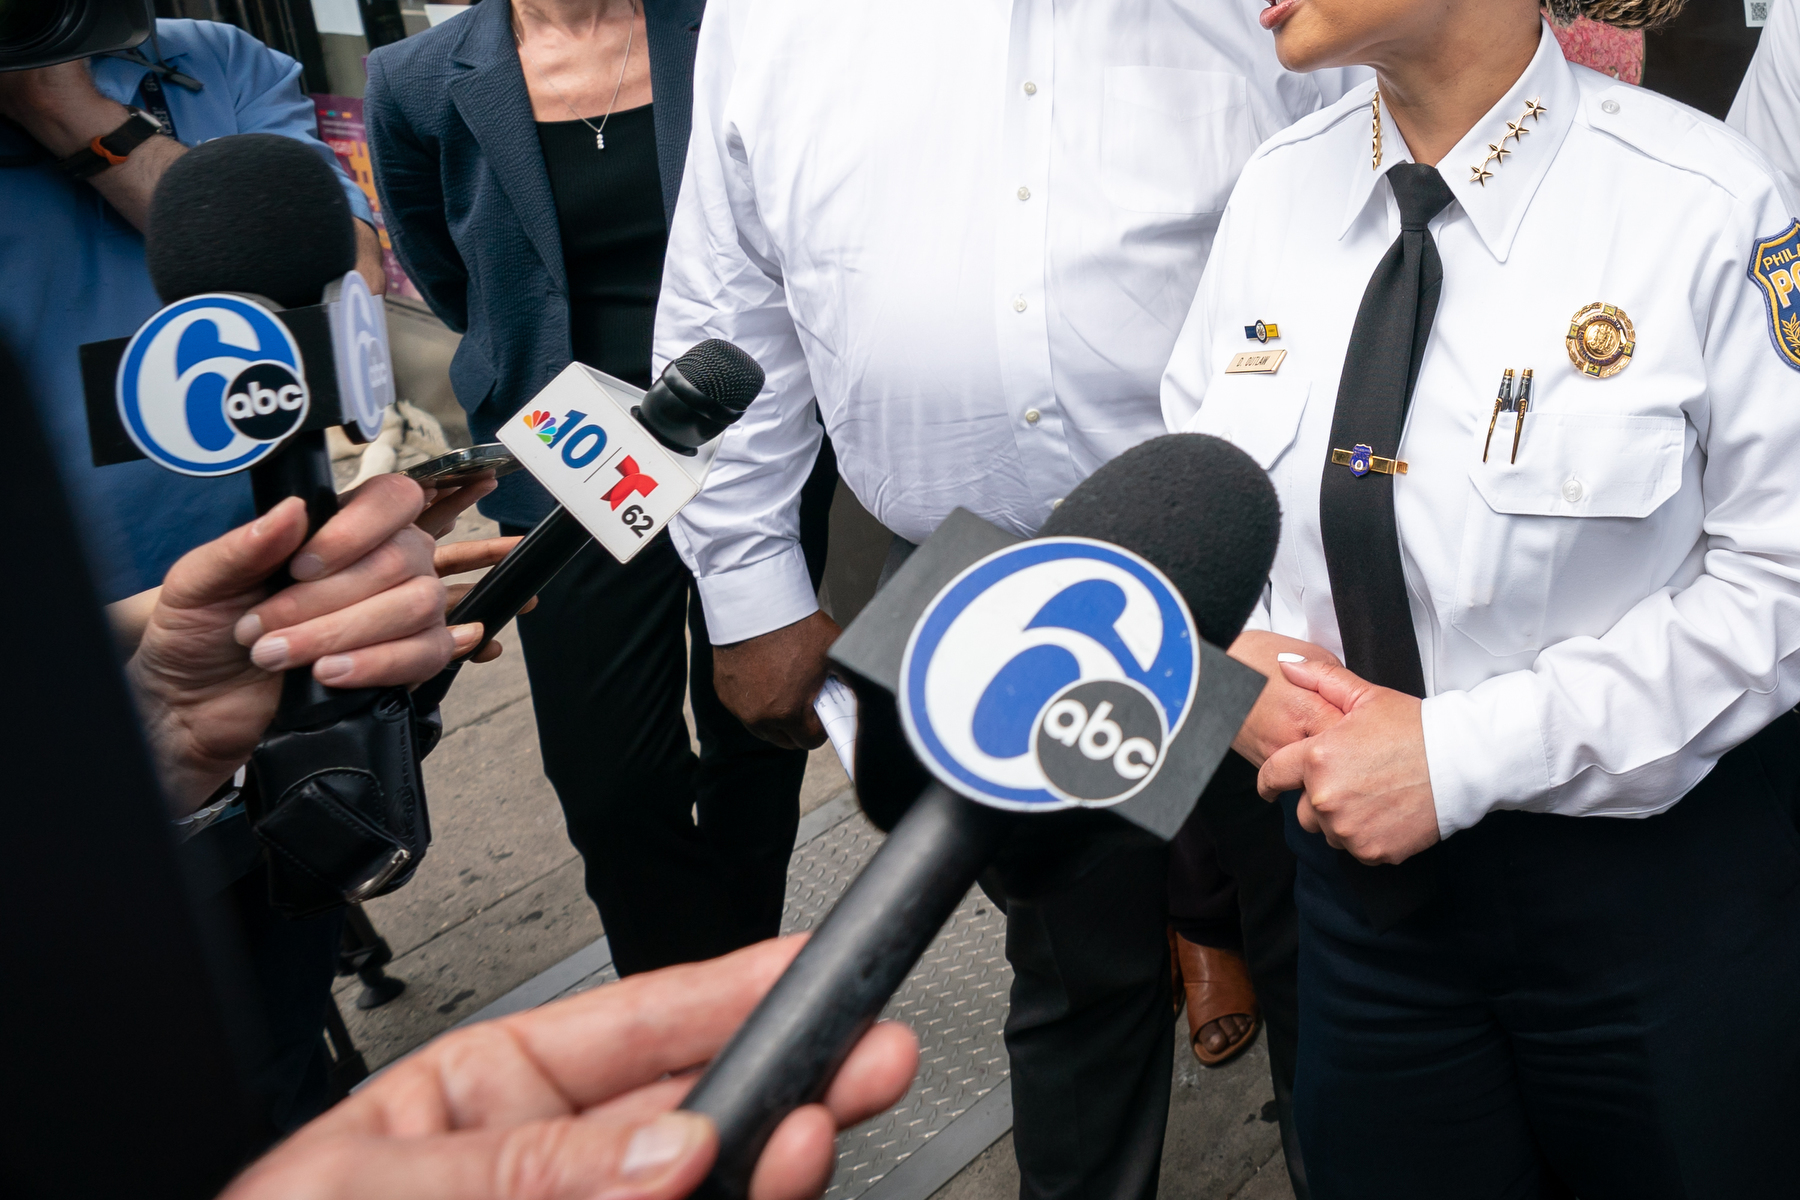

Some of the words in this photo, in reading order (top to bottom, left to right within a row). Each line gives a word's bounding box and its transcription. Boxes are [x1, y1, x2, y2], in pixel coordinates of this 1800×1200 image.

[137, 307, 262, 465] 6
[225, 381, 302, 420] abc
[547, 409, 608, 469] 10
[621, 504, 654, 539] 62
[924, 557, 1164, 790] 6
[1043, 699, 1157, 780] abc
